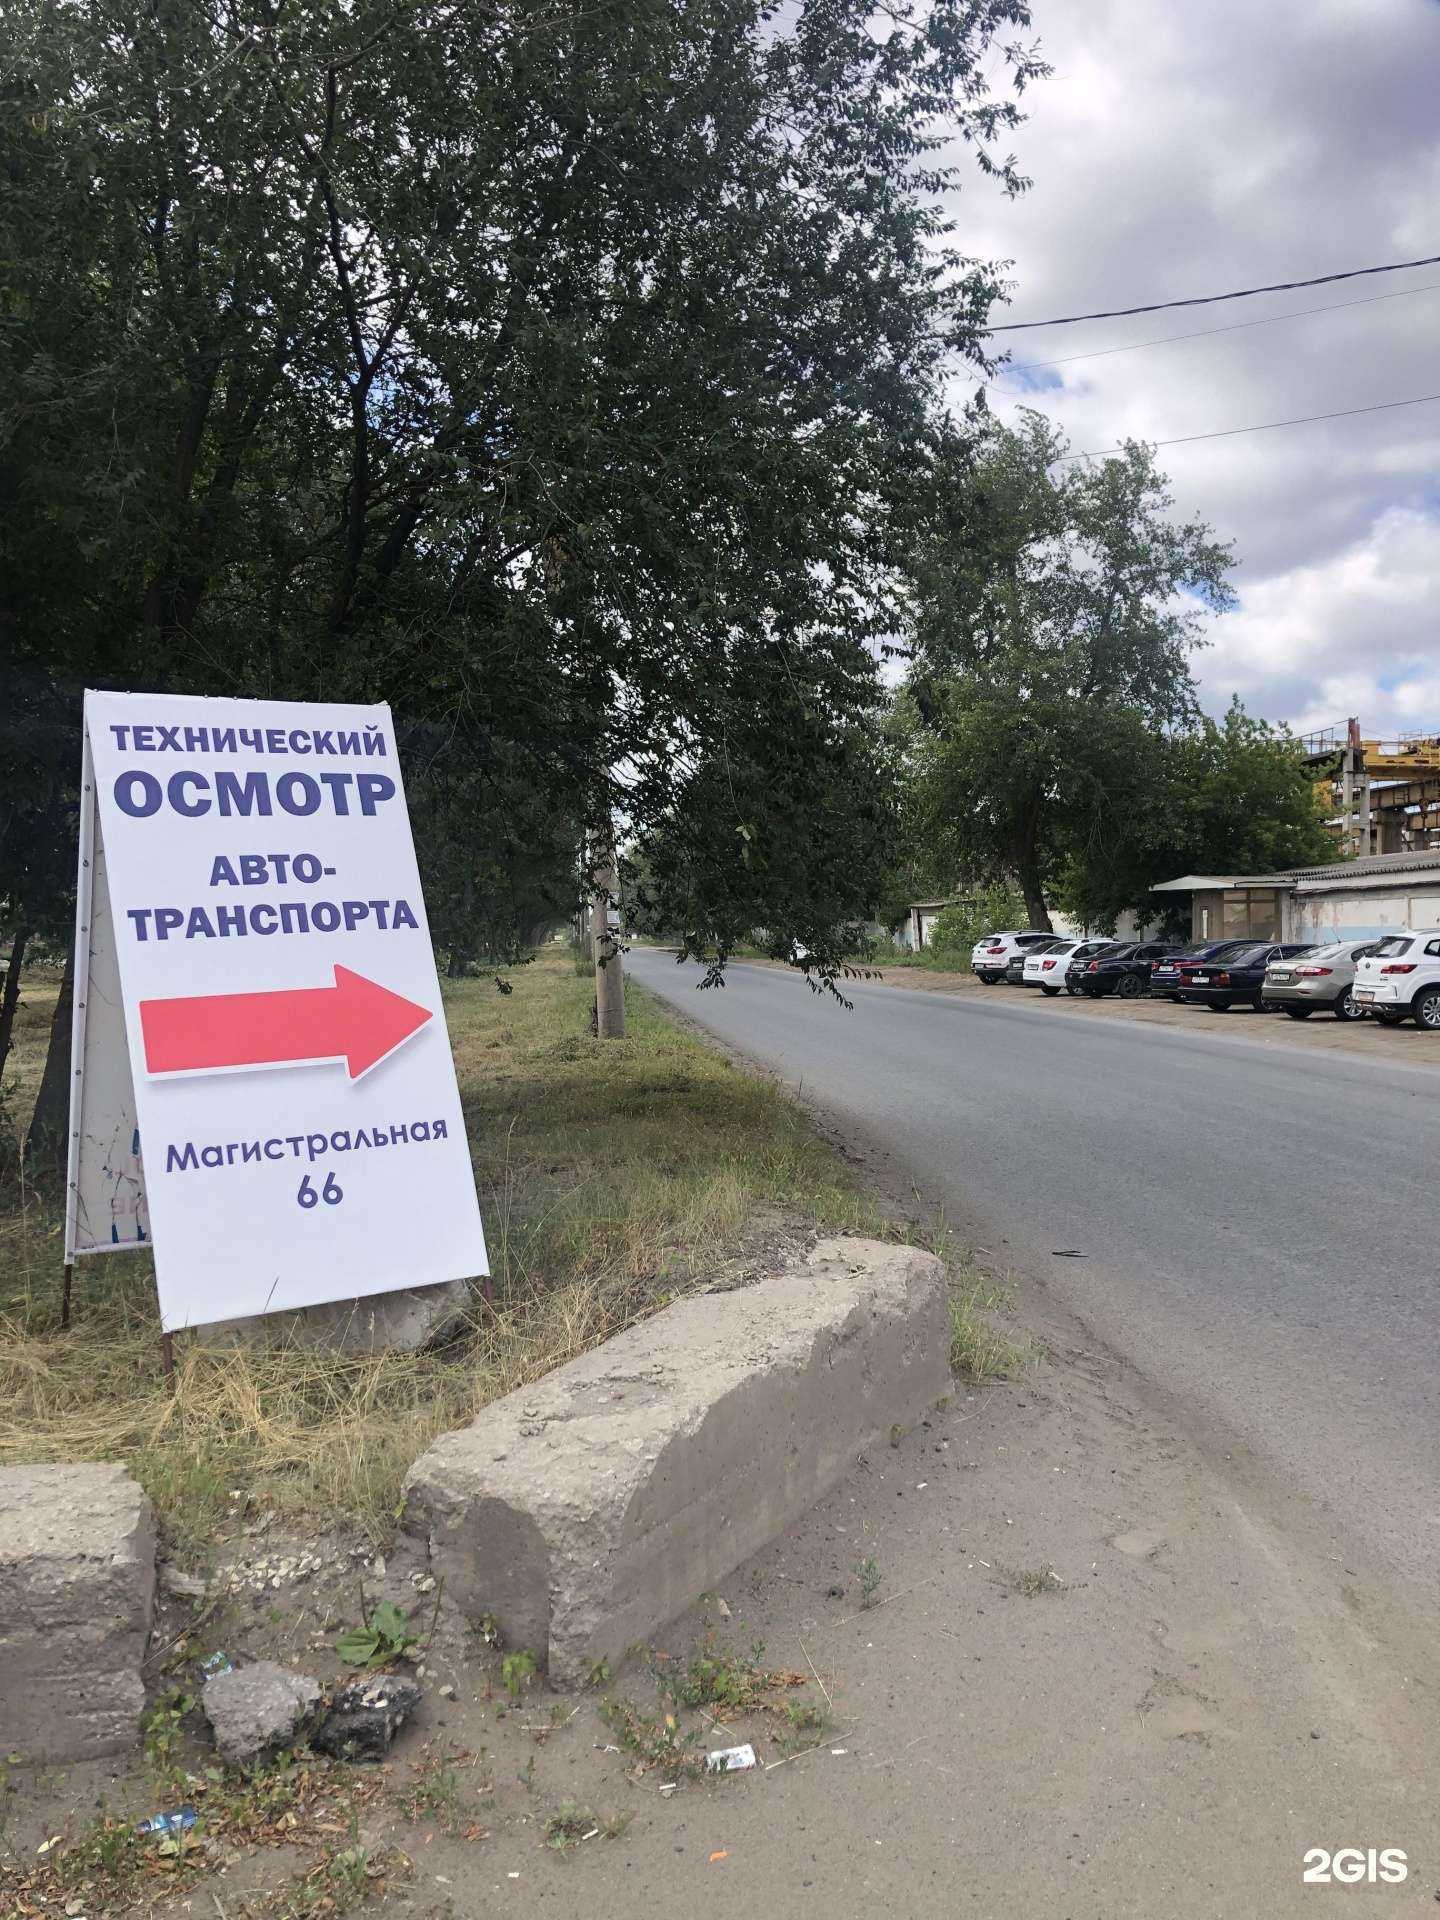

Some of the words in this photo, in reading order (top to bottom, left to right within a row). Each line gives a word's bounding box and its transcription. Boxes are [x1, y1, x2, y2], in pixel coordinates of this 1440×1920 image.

[110, 724, 387, 757] ТЕХНИЧЕСКИЙ
[114, 771, 396, 817] ОСМОТР
[209, 854, 337, 887] АВТО-
[127, 900, 419, 941] ТРАНСПОРТА
[166, 1119, 448, 1172] Магистральная
[297, 1172, 344, 1209] 66
